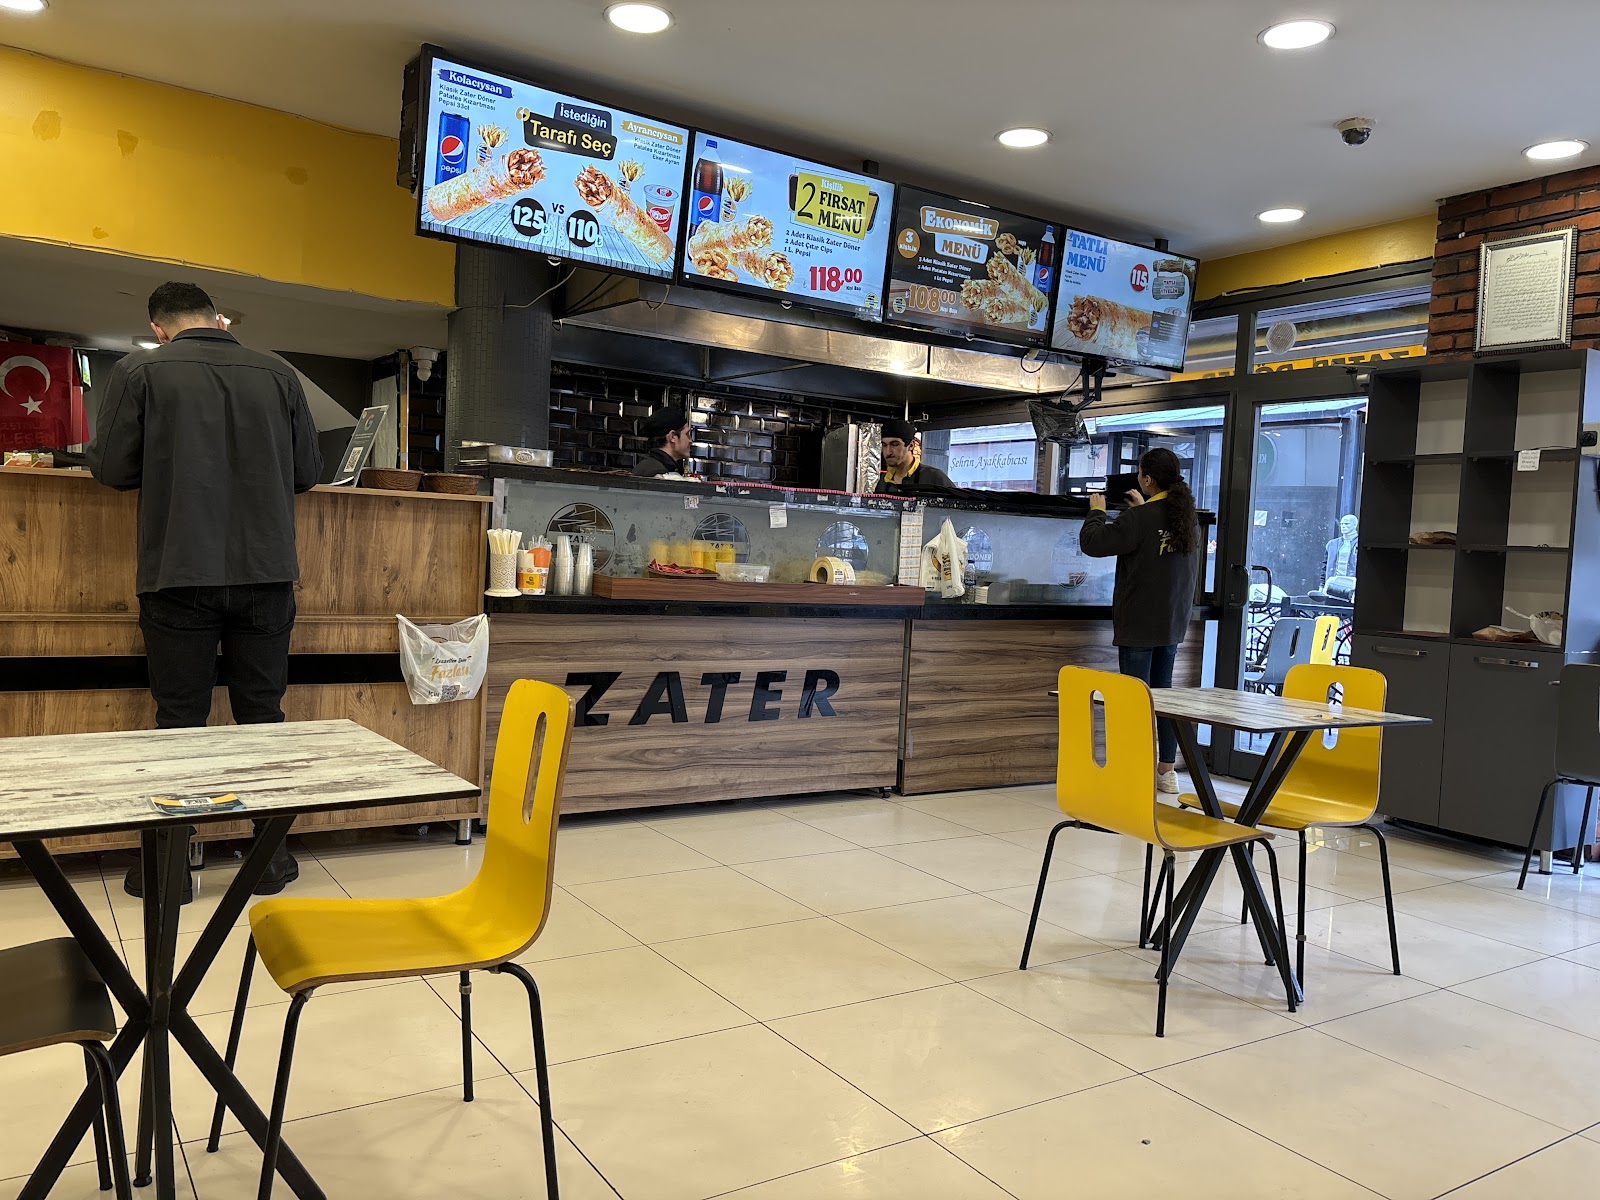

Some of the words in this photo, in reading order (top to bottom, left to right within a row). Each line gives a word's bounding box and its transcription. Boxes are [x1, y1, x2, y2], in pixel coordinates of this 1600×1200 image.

[440, 83, 458, 94] Klasik
[459, 89, 476, 99] Zater
[477, 94, 496, 104] Döner
[449, 71, 503, 95] Kolacıysan
[438, 91, 462, 102] Patates
[463, 97, 496, 111] Kızartması
[438, 97, 456, 107] Pepsi
[560, 103, 607, 128] İstediğin
[529, 119, 577, 146] Tarafı
[581, 133, 612, 157] Seç
[627, 121, 678, 143] Ayrancıysan
[633, 142, 653, 153] Patates
[797, 182, 815, 219] 2
[819, 190, 866, 215] FIRSAT
[817, 208, 863, 235] MENÜ
[789, 239, 804, 247] Adet
[790, 230, 806, 239] Adet
[806, 233, 825, 243] Klasik
[825, 237, 843, 248] Zater
[843, 241, 861, 251] Döner
[905, 231, 914, 243] 3
[1070, 232, 1108, 256] TATLI
[795, 248, 811, 257] Pepsi
[941, 239, 982, 259] MENÜ
[1066, 252, 1107, 272] MENÜ
[950, 455, 974, 472] Şehrin
[975, 453, 1028, 470] Ayakkabıcısı
[564, 669, 841, 727] ZATER
